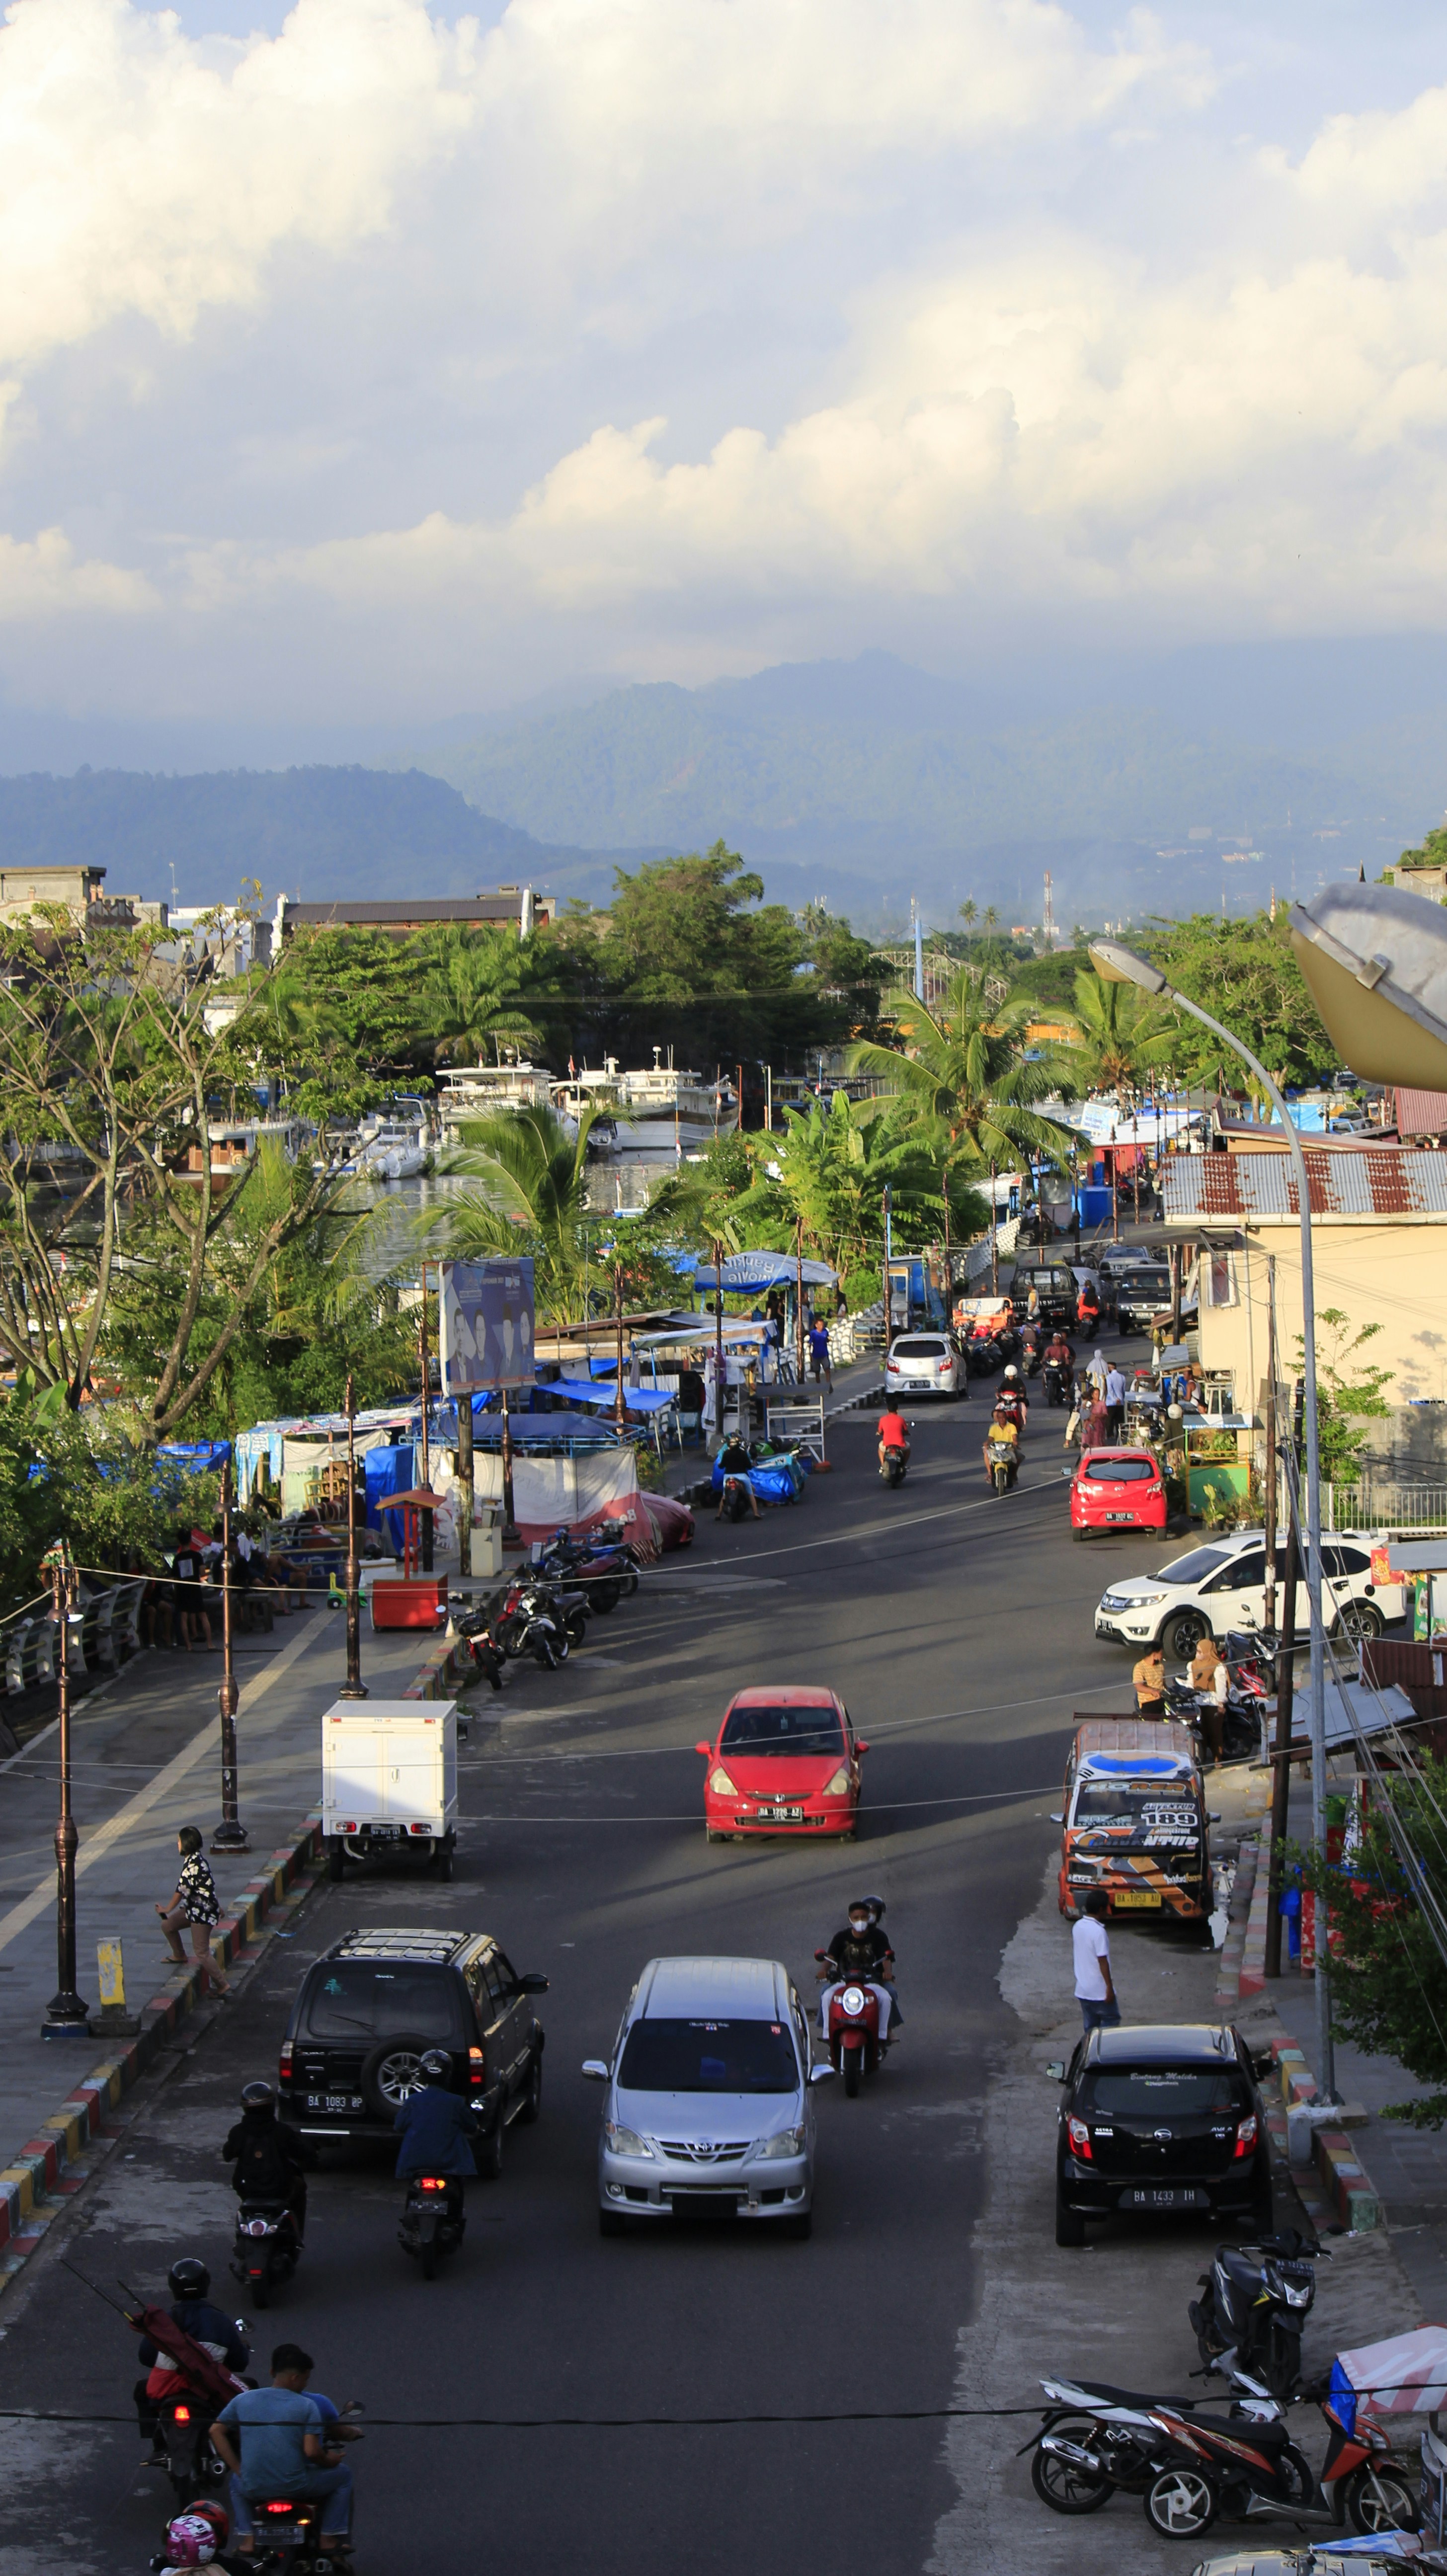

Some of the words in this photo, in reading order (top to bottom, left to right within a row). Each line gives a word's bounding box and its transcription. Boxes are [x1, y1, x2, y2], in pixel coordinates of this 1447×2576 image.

[1140, 1811, 1197, 1826] 189
[308, 2095, 319, 2106] BA
[325, 2096, 346, 2107] 1083
[1134, 2191, 1145, 2201] BA
[1153, 2190, 1174, 2201] 1433
[1184, 2190, 1195, 2201] IH
